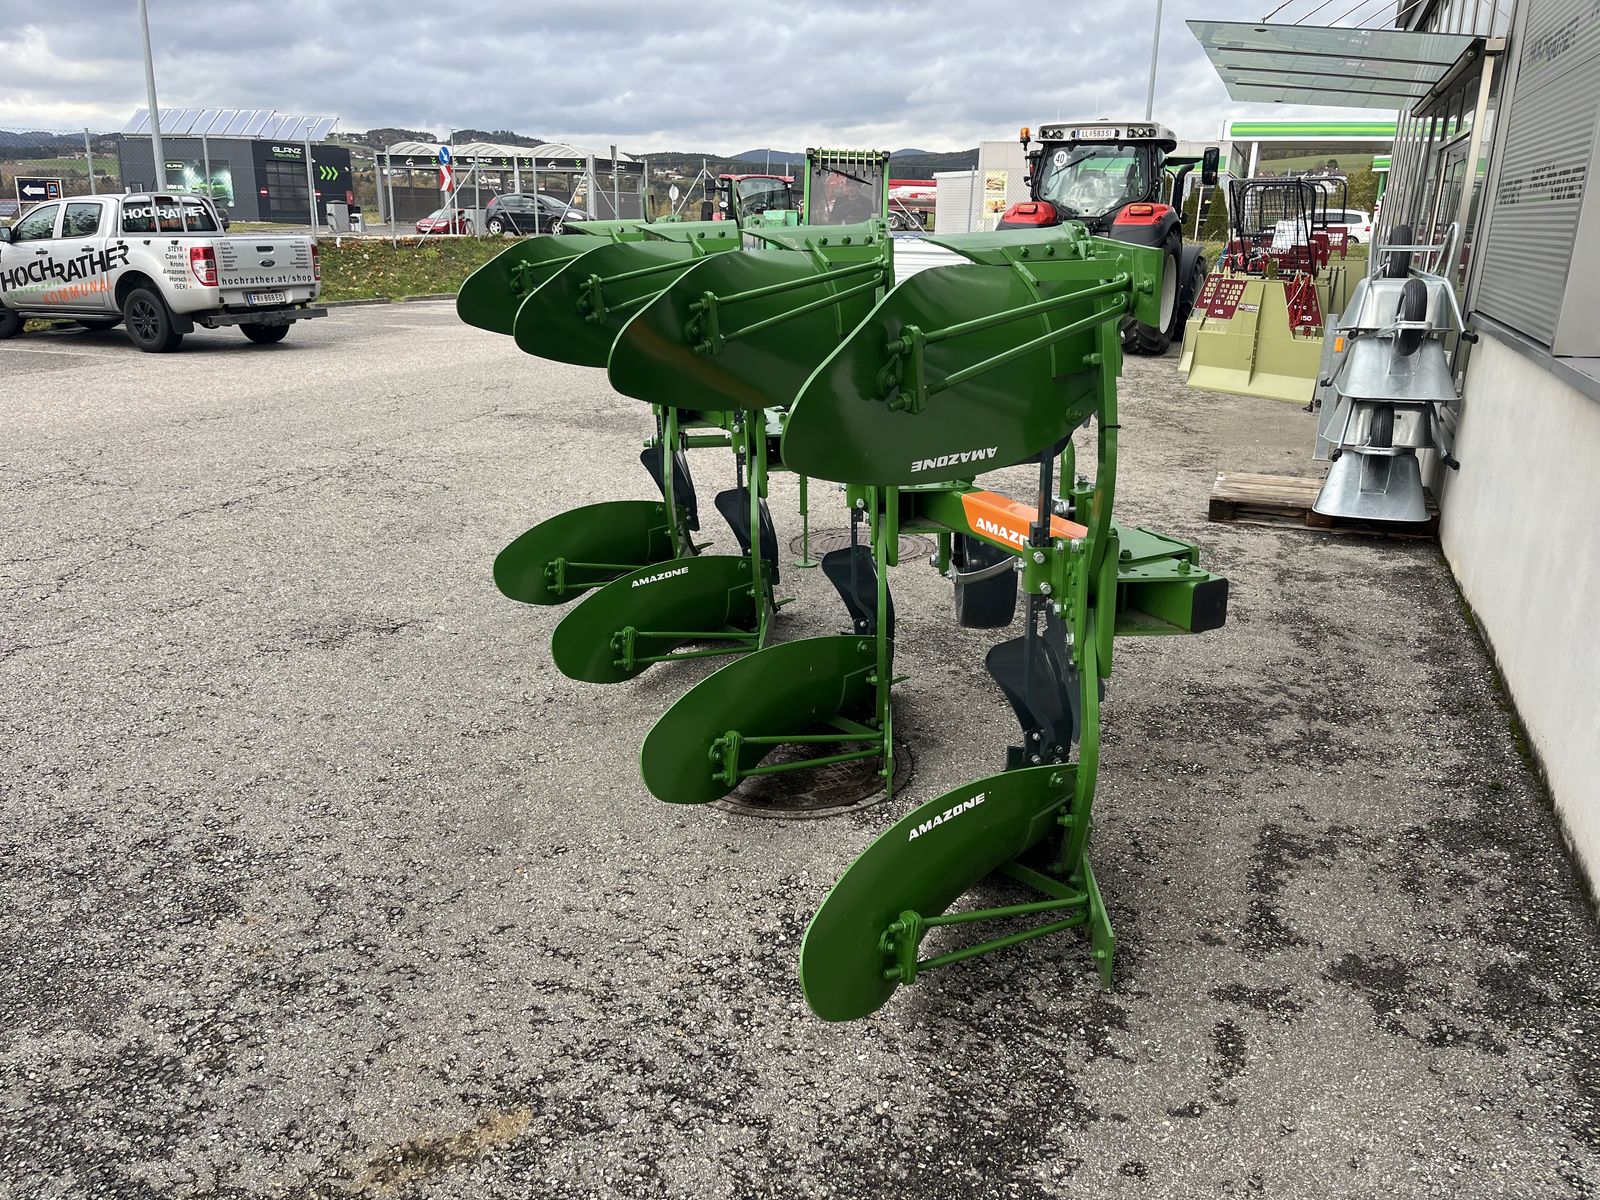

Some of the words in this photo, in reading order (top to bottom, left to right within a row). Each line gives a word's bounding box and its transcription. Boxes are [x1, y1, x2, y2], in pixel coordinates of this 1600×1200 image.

[1056, 153, 1066, 164] 40
[122, 205, 206, 220] HOCHRATHER
[0, 245, 130, 292] HOCHRATHER
[222, 274, 312, 286] hochrather.at/shop
[42, 271, 114, 305] KOMMUNAL
[910, 446, 998, 472] AMAZONE
[631, 566, 689, 588] AMAZONE
[908, 792, 986, 842] AMAZONE
